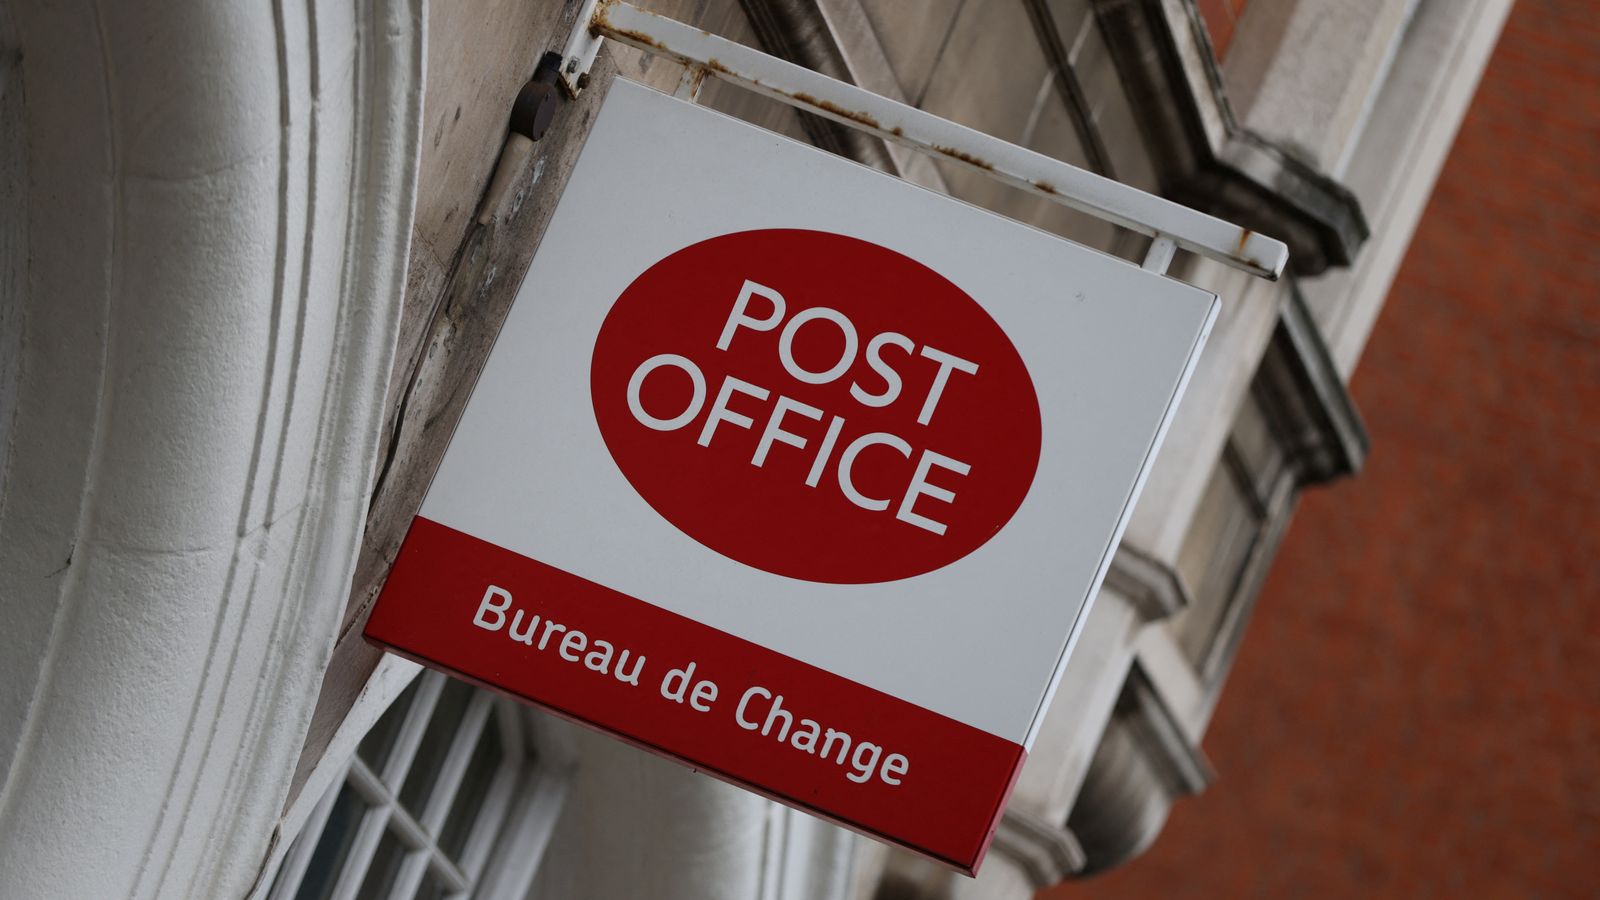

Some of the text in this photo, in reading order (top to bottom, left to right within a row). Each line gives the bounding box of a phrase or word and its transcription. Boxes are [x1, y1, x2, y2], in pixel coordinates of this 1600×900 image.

[716, 280, 979, 425] POST
[627, 354, 971, 535] OFFICE
[472, 585, 909, 785] Bureau de Change
